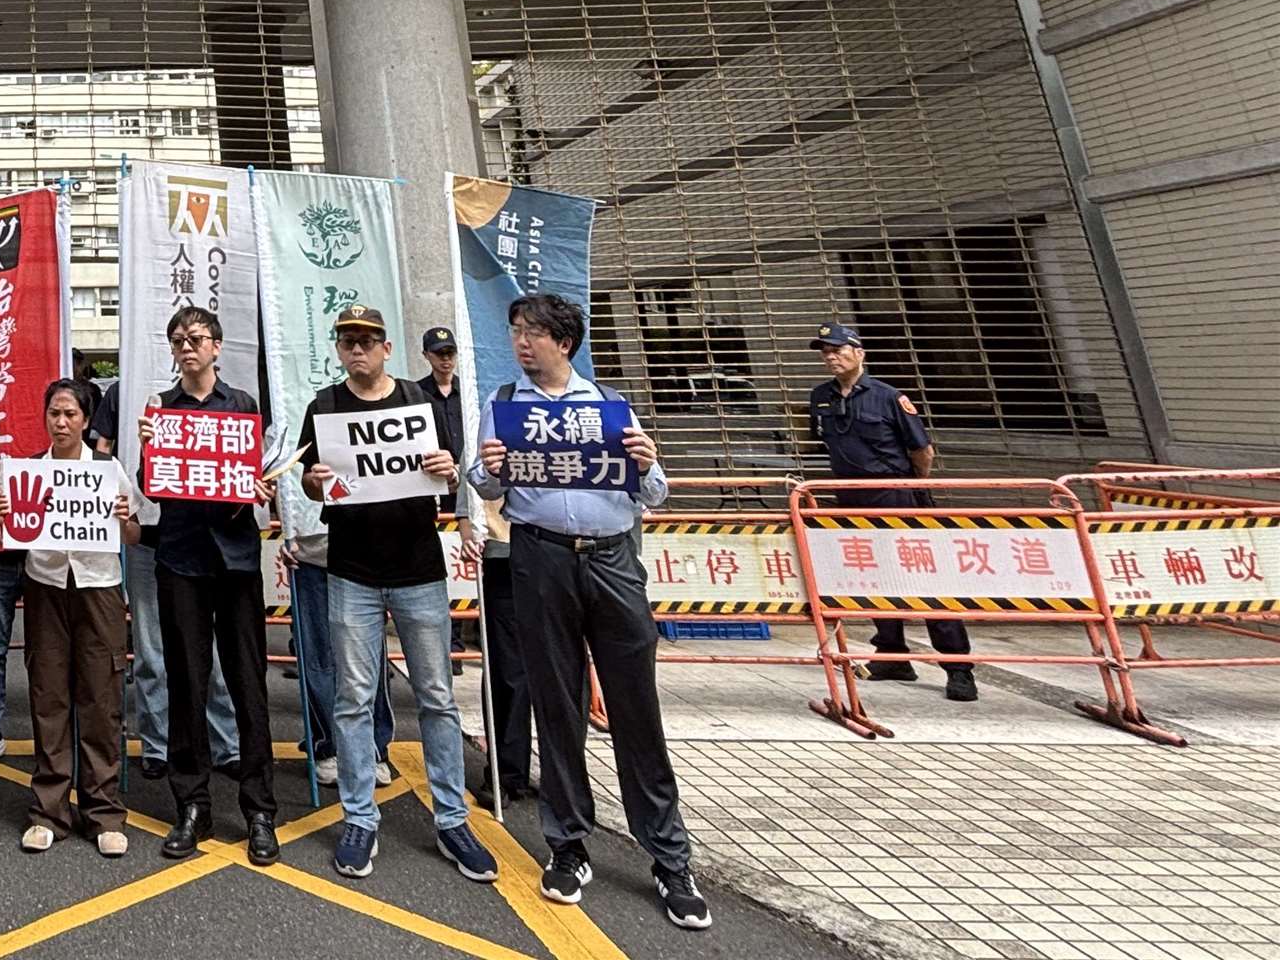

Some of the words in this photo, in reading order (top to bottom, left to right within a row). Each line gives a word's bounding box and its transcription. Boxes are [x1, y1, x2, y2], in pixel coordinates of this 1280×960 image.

[149, 413, 255, 455] 經濟部
[347, 415, 427, 446] NCP
[523, 406, 605, 445] 永續
[53, 469, 103, 491] Dirty
[149, 455, 256, 499] 莫再拖
[507, 451, 627, 486] 競爭力
[13, 511, 40, 530] NO
[45, 495, 114, 519] Supply
[50, 521, 108, 542] Chain
[652, 549, 798, 586] 止停車
[837, 536, 1055, 576] 車輛改道
[1105, 545, 1265, 587] 車輛改
